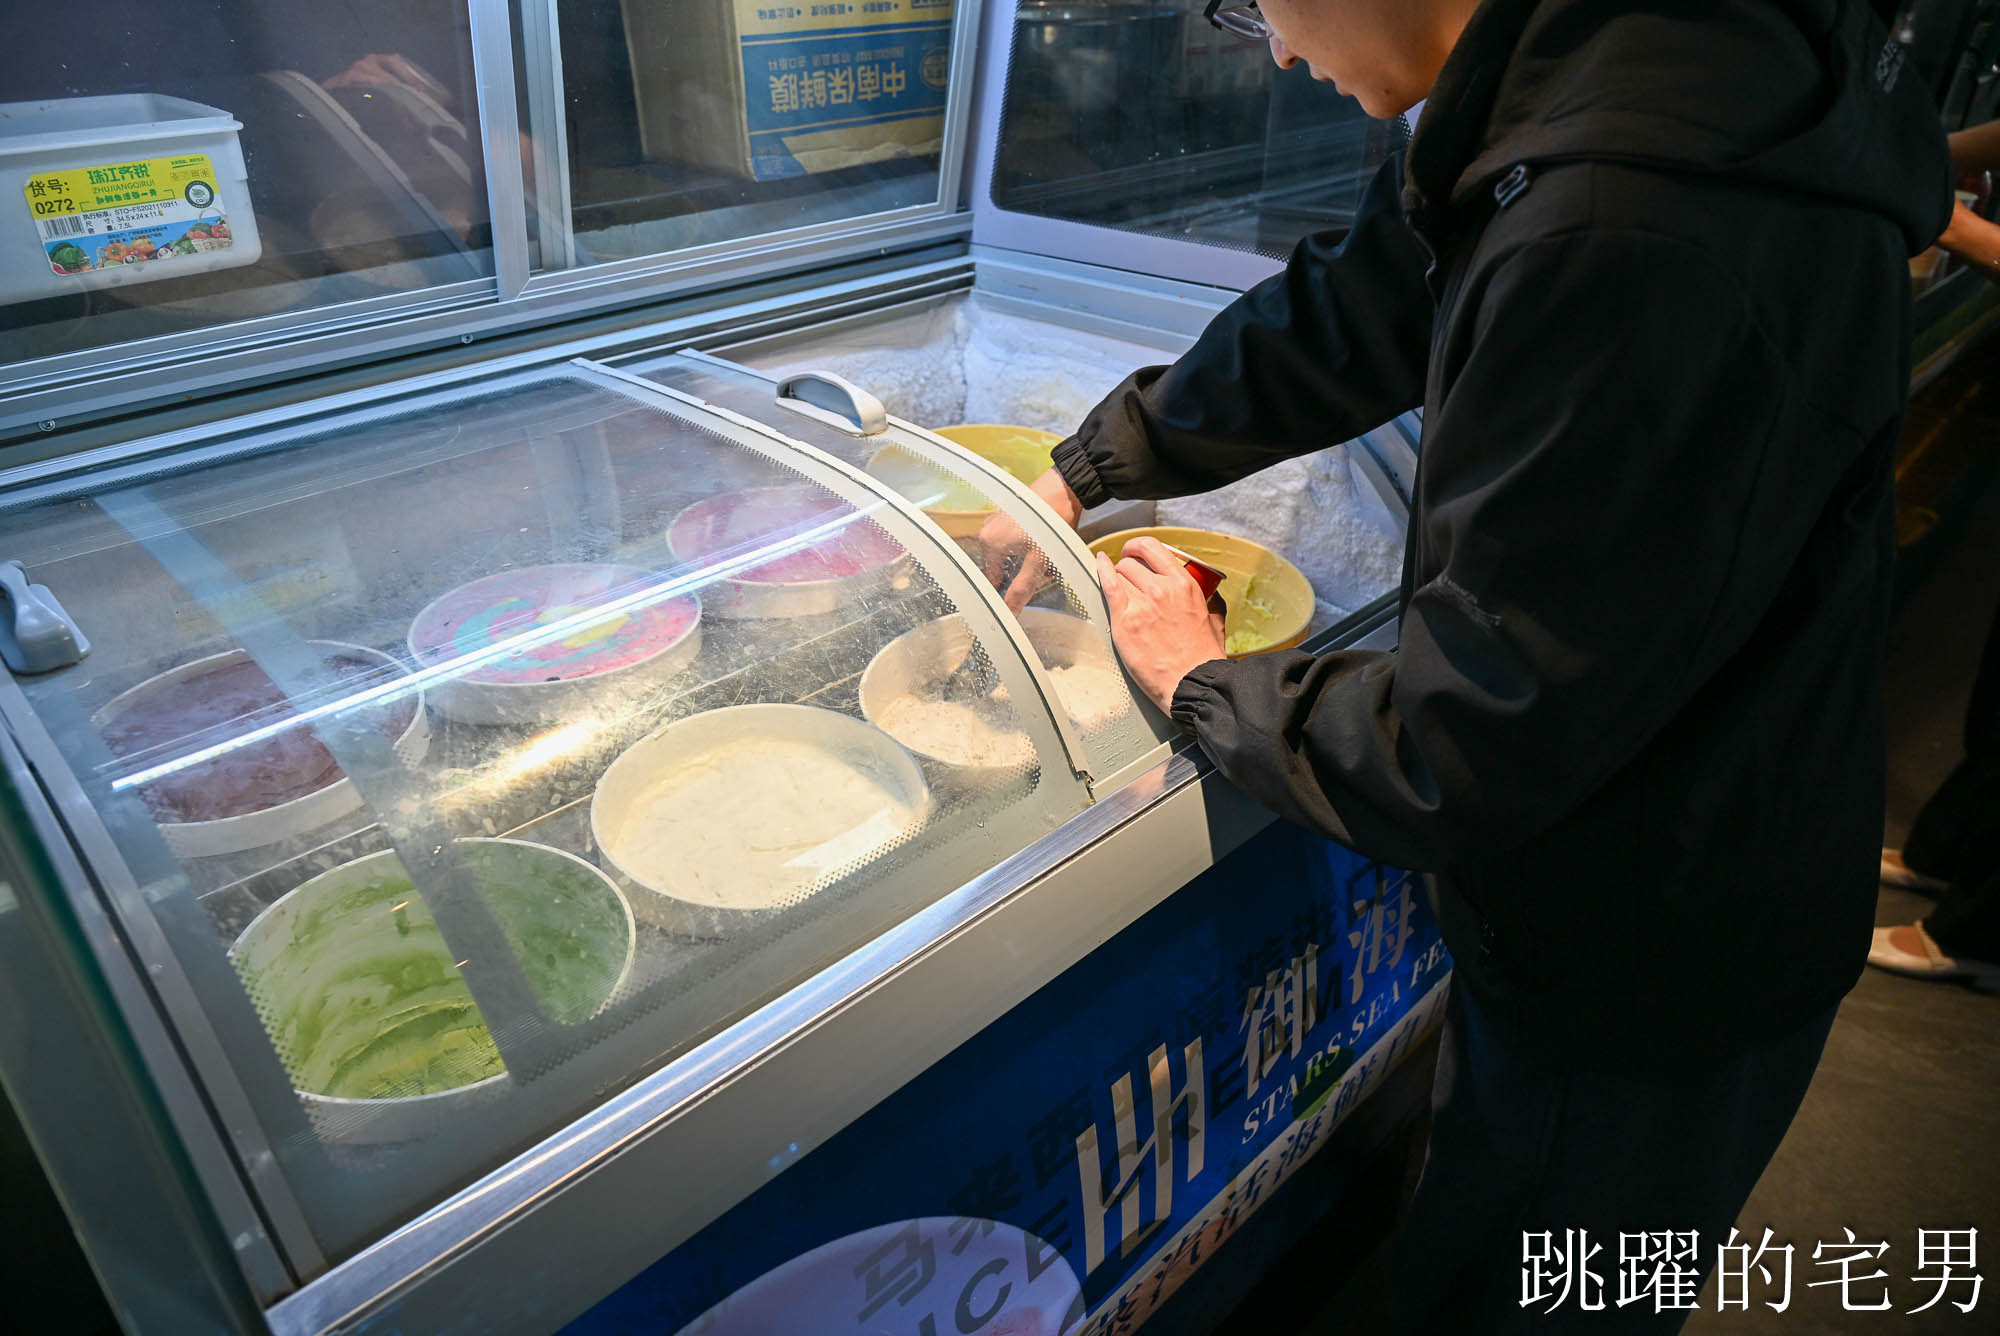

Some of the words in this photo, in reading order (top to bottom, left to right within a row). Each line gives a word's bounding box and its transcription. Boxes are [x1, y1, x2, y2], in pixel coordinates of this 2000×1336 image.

[768, 61, 907, 114] 中南保鲜膜
[93, 180, 156, 194] ZHUJIANGQIRUI
[35, 198, 75, 215] 0272
[1241, 1031, 1342, 1146] STARS
[1349, 979, 1401, 1046] SEA
